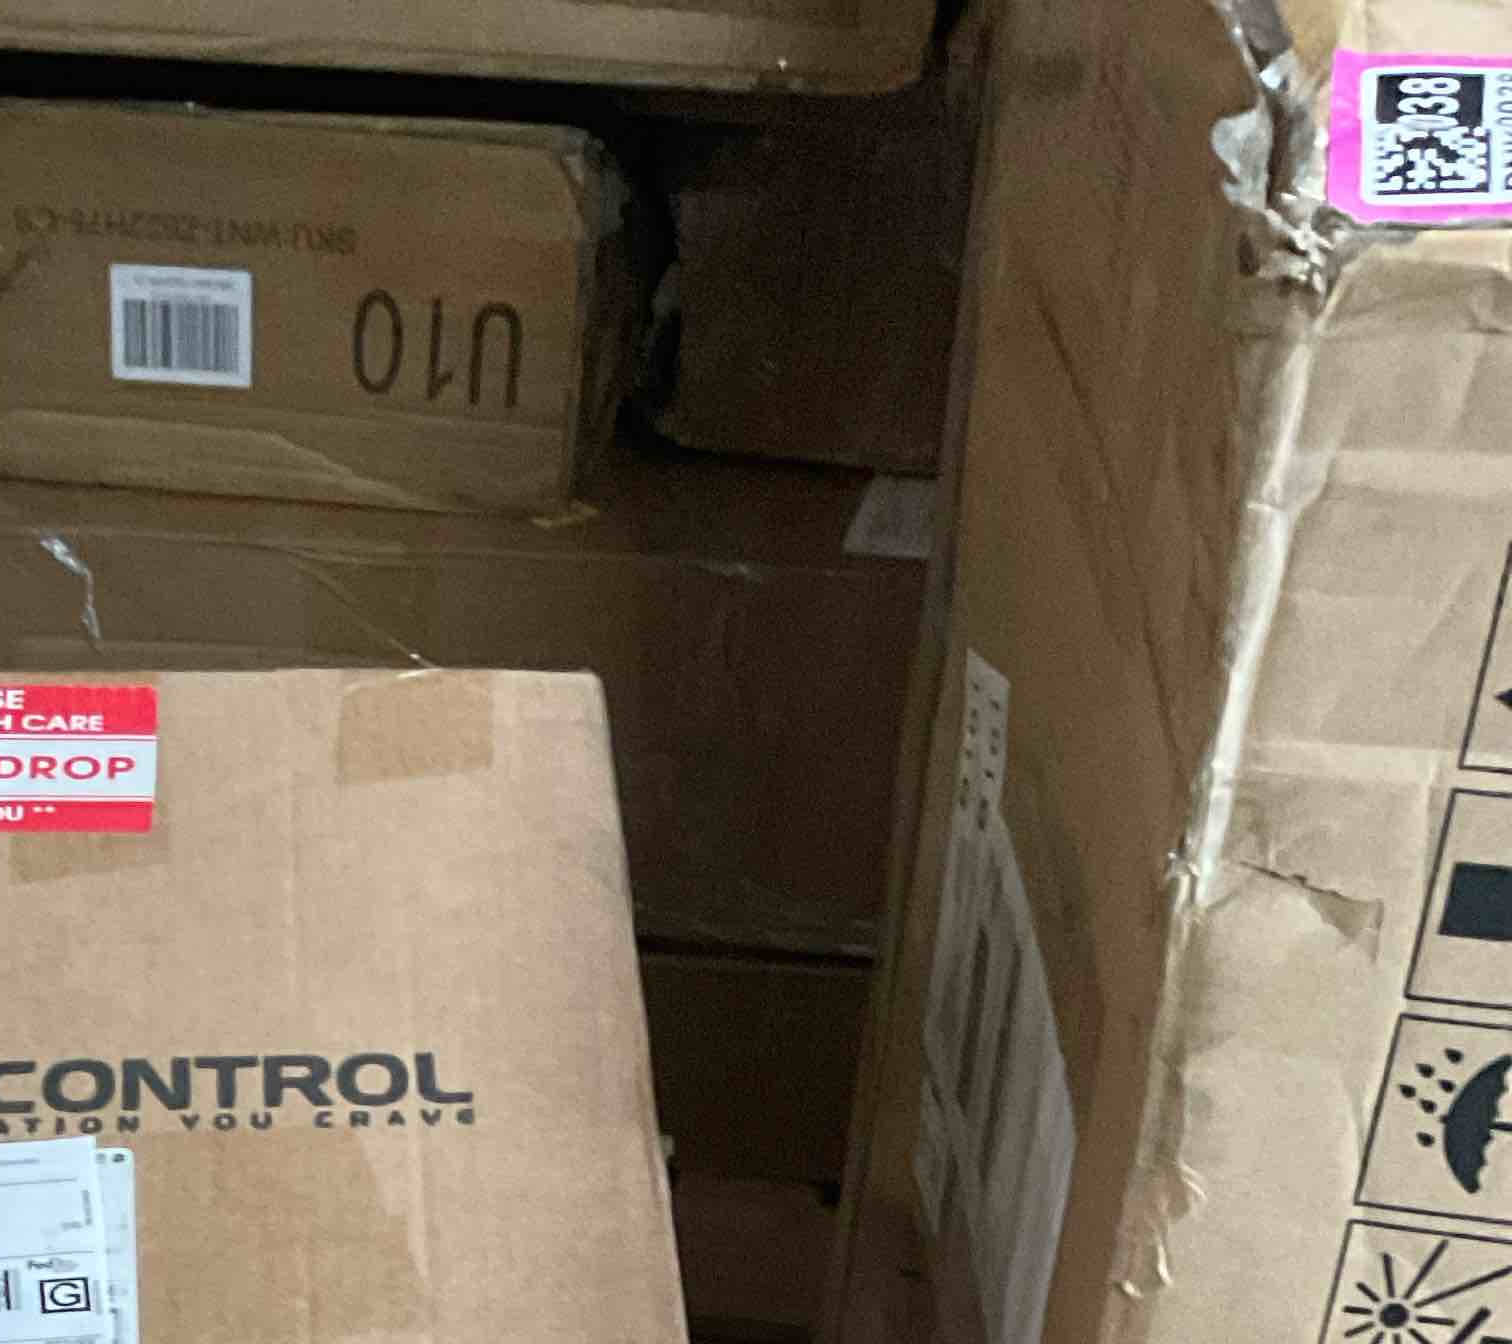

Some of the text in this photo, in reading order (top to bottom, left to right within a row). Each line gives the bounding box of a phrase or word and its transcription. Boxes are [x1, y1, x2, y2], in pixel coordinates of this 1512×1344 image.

[354, 288, 523, 408] U10
[21, 713, 104, 732] CARE
[180, 1112, 273, 1132] YOU
[313, 1108, 476, 1130] CRAVE
[49, 1282, 81, 1307] G
